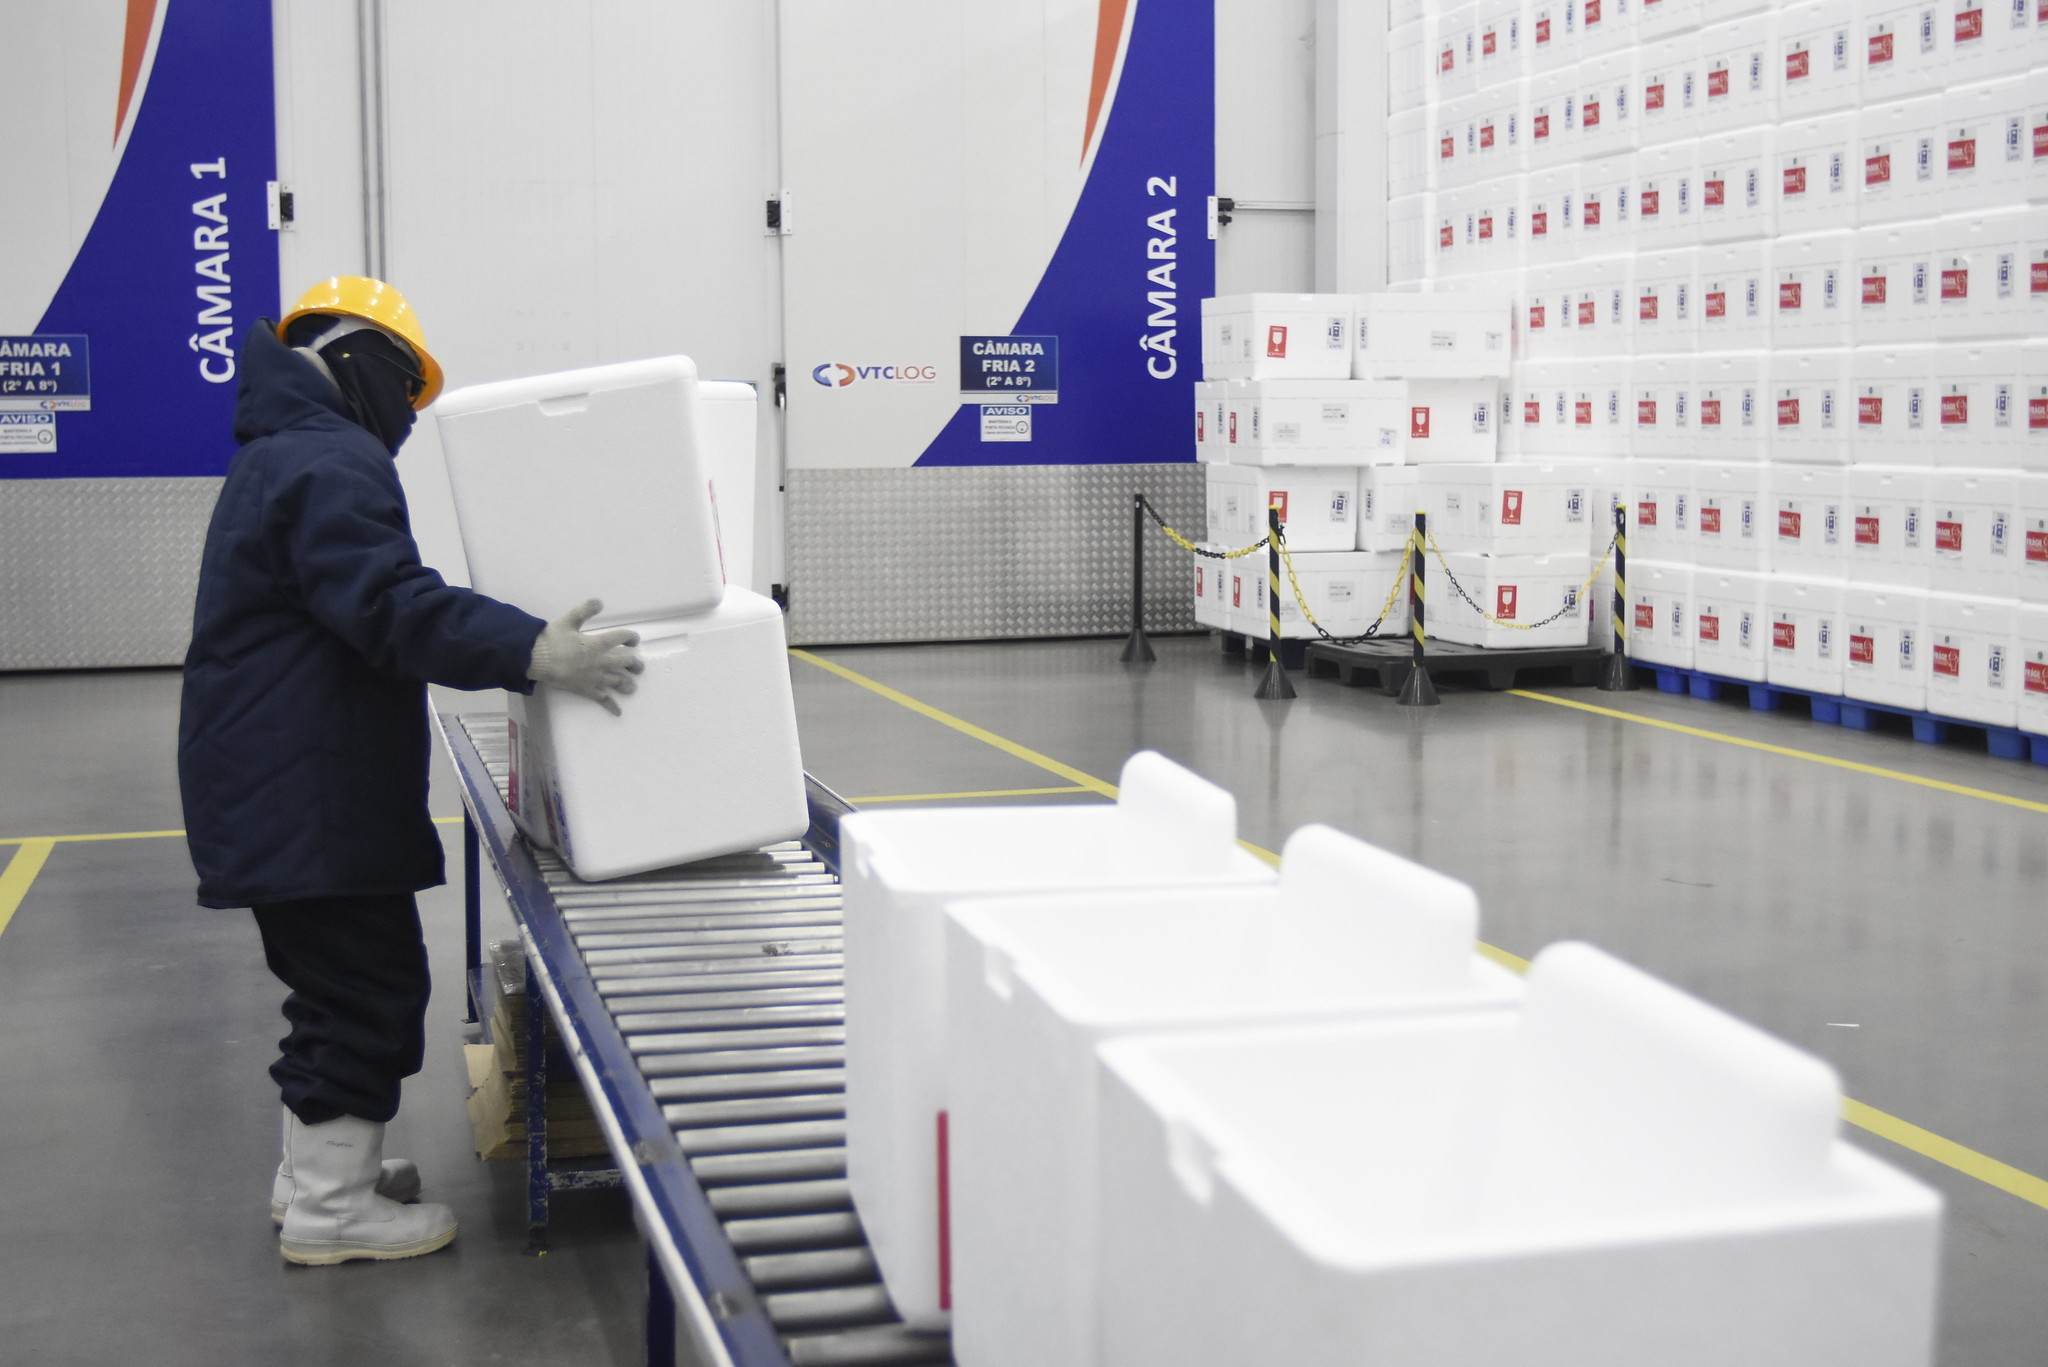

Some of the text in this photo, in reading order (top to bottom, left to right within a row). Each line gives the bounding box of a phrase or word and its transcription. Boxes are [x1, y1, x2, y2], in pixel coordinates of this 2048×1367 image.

[188, 157, 236, 384] CÂMARA 1
[1139, 176, 1177, 380] CÂMARA 2
[0, 340, 72, 357] ÂMARA
[972, 340, 1044, 355] CÂMARA
[0, 361, 61, 376] FRIA 1
[857, 366, 937, 380] VTCLOG
[982, 360, 1036, 373] FRIA 2
[1004, 377, 1013, 386] A
[986, 407, 1027, 415] AVISO
[1, 415, 50, 425] AVISO
